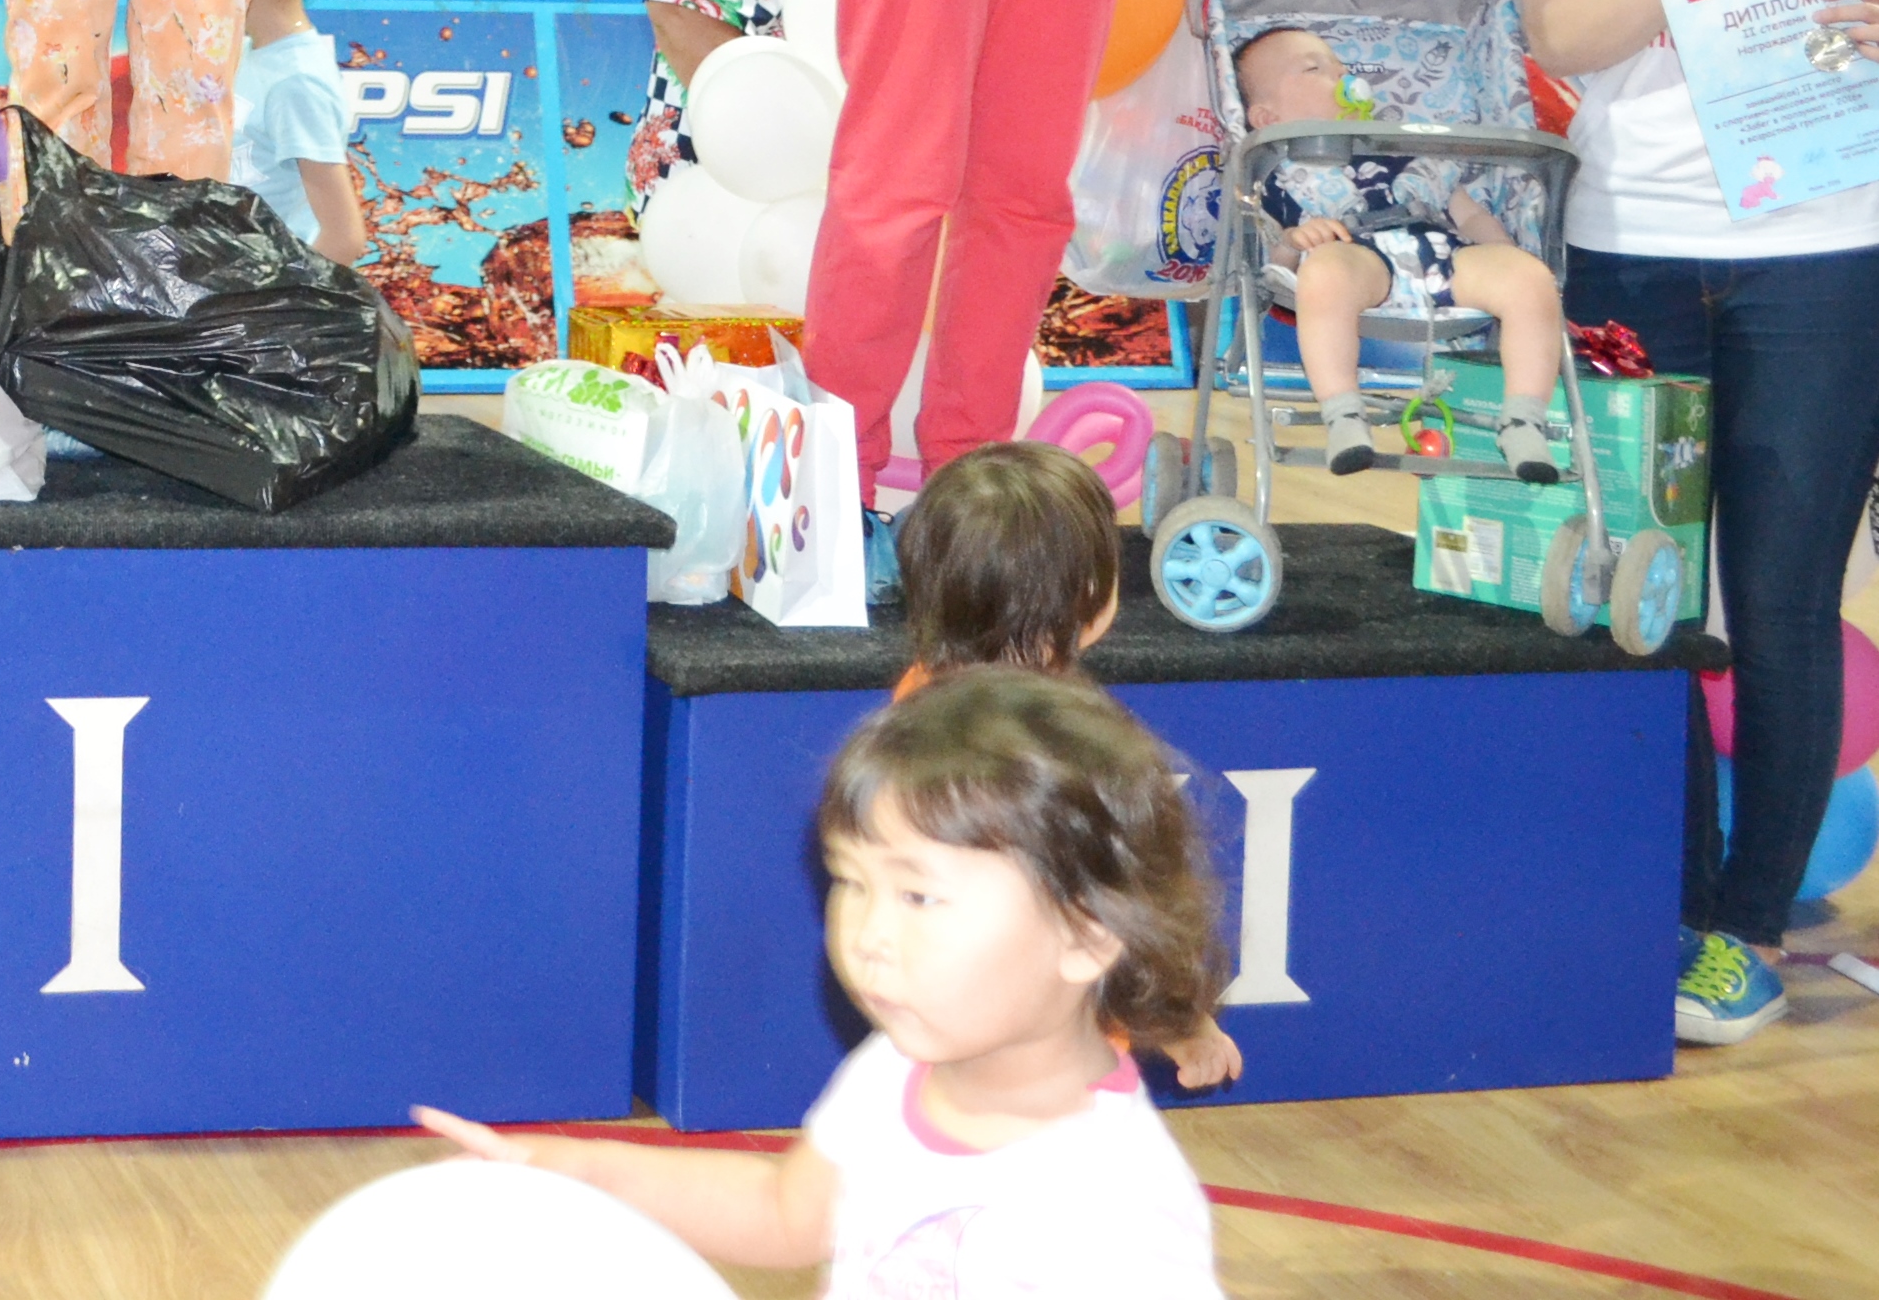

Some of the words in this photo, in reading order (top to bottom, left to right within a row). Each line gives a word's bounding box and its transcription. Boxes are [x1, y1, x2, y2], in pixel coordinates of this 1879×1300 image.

[1760, 14, 1808, 35] степени
[341, 70, 512, 135] PSI
[39, 696, 151, 995] I
[1171, 768, 1318, 1006] I
